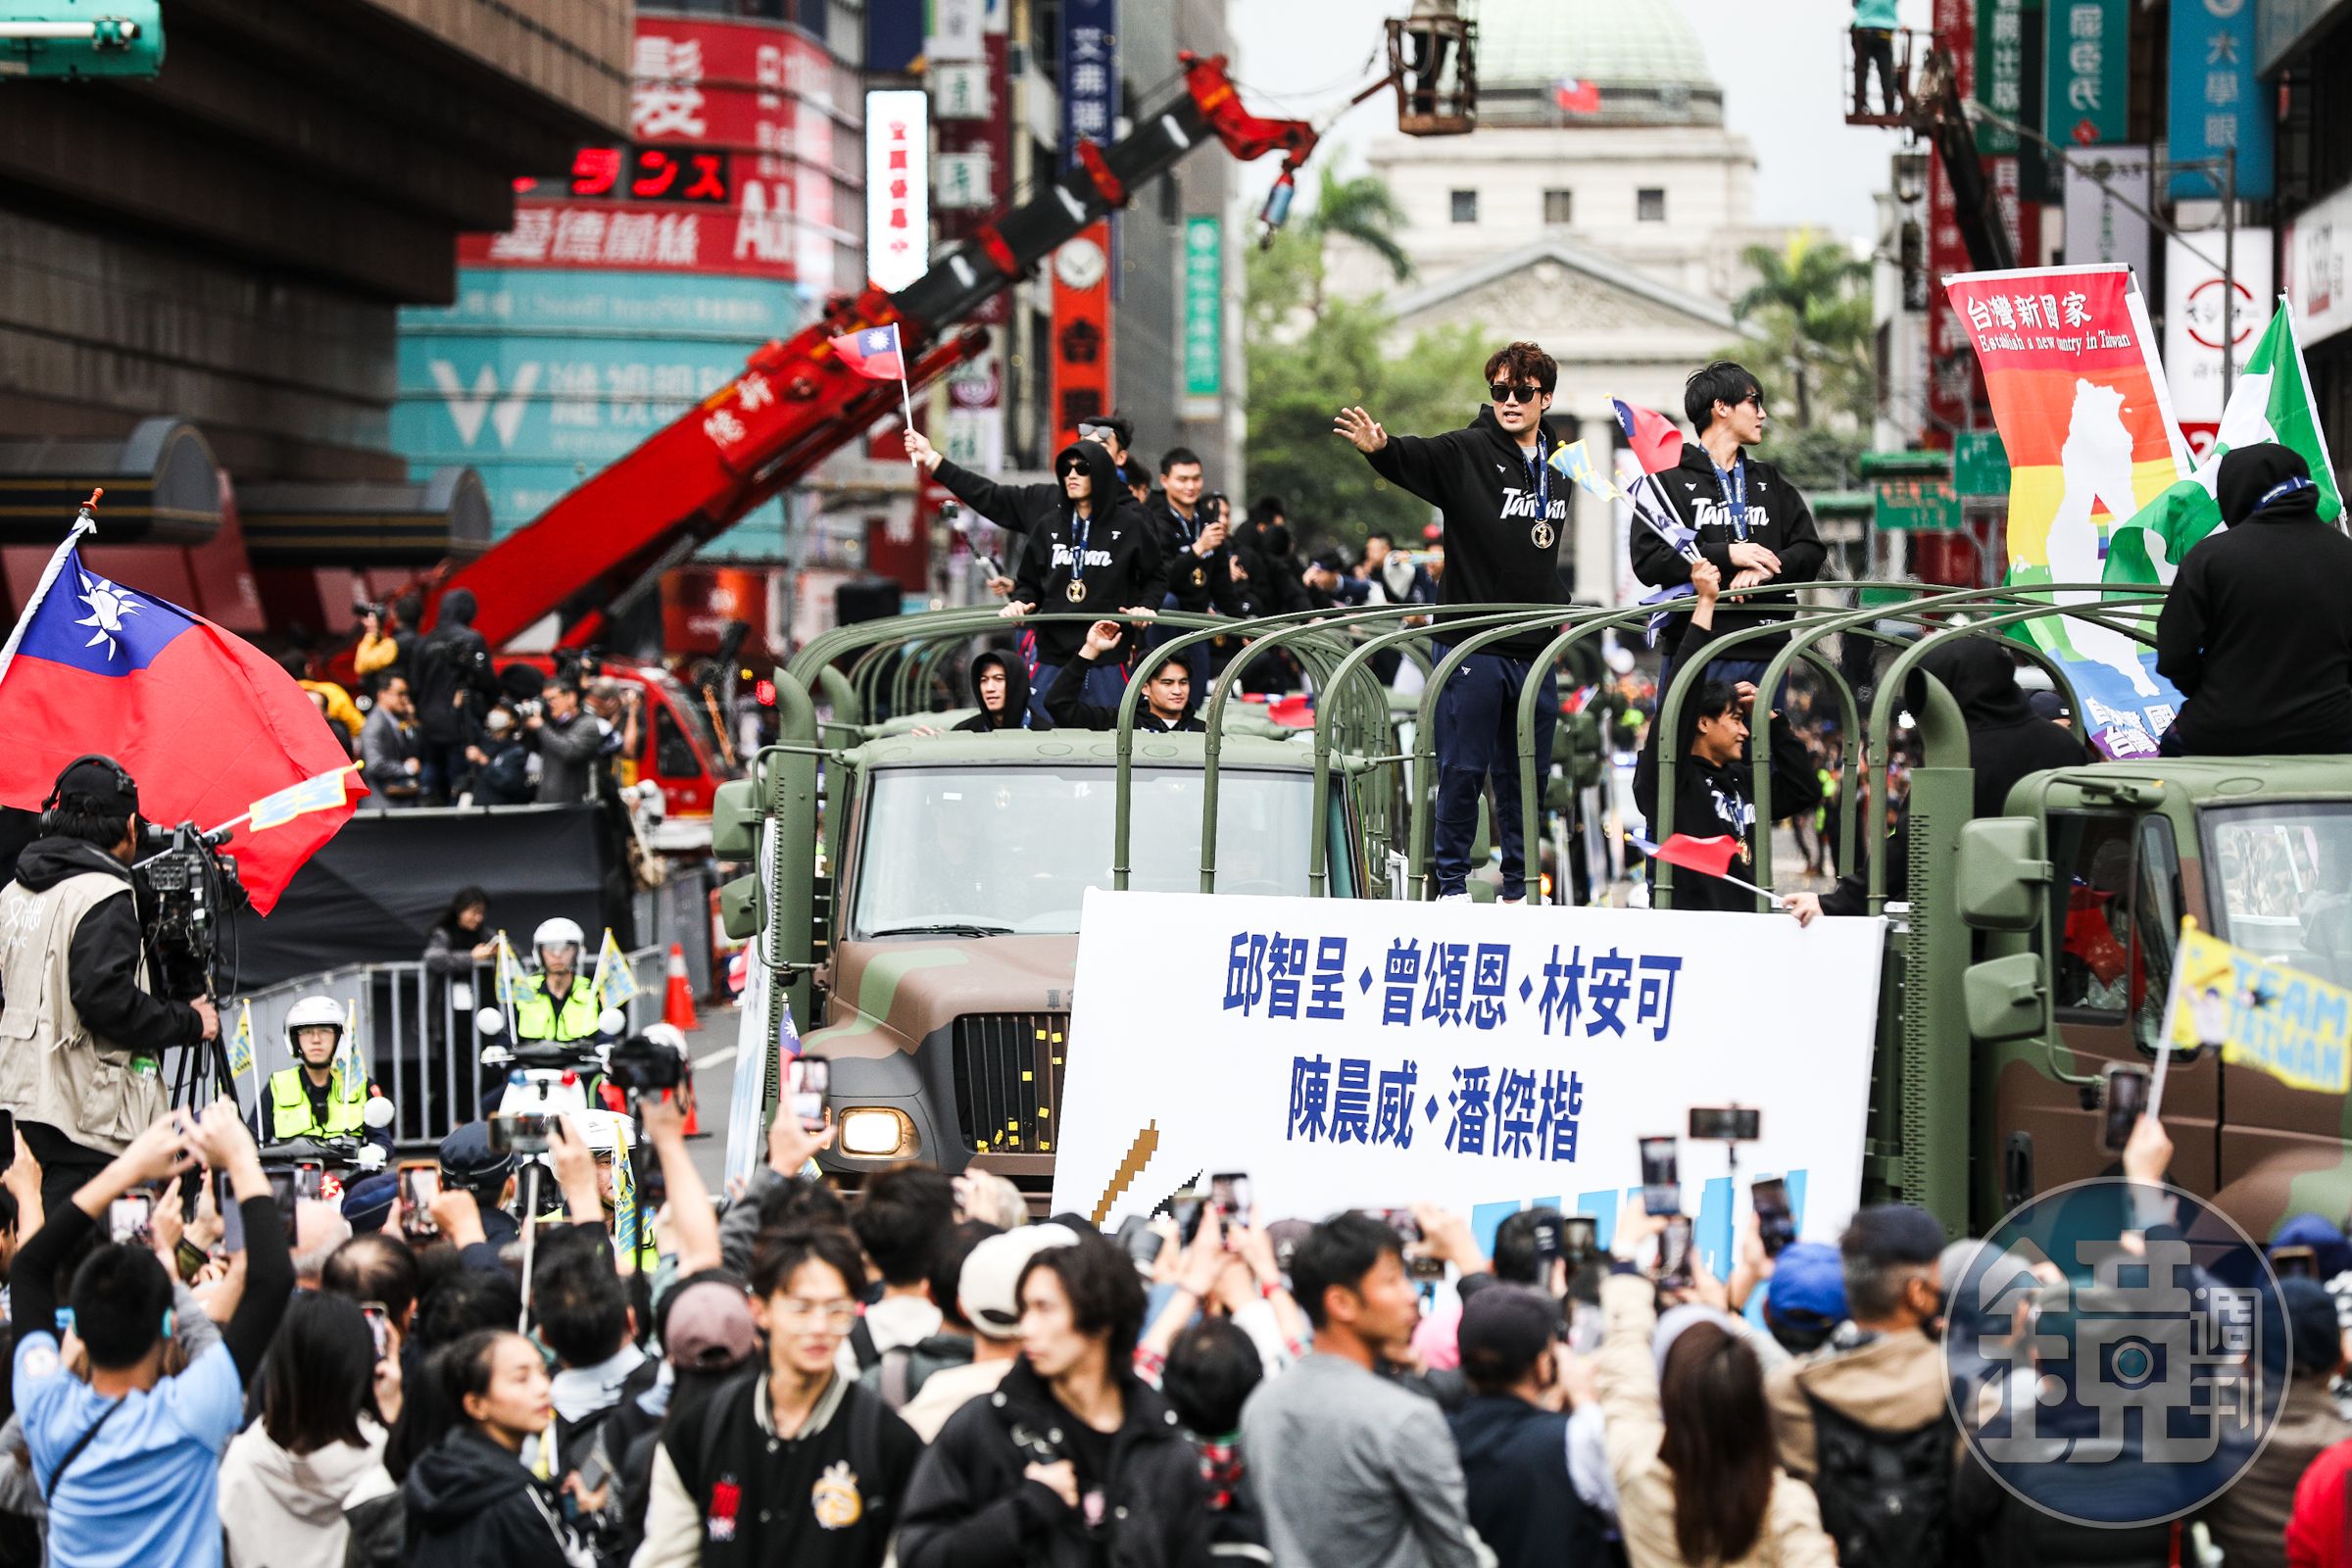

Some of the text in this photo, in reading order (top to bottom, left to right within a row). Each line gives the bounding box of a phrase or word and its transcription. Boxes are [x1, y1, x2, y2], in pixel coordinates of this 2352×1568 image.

[2085, 330, 2098, 351] in
[1500, 487, 1567, 519] Taian
[1690, 497, 1770, 530] Taian
